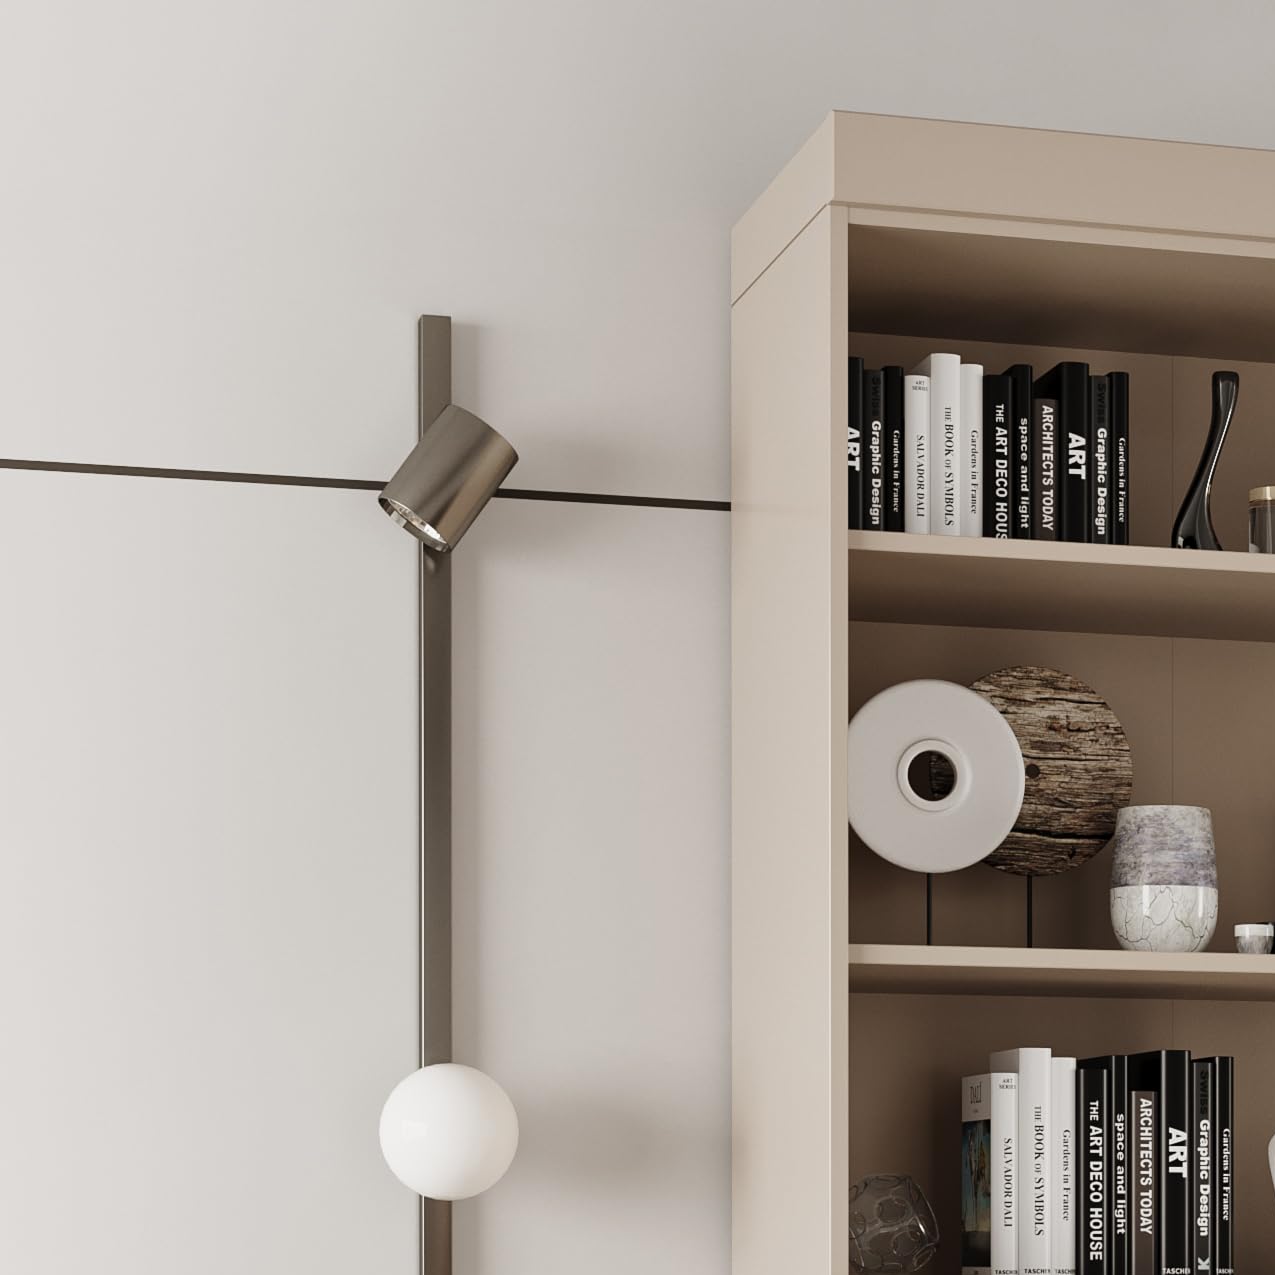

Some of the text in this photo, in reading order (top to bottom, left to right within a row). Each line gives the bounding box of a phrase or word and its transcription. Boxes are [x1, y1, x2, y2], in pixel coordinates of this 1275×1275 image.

[995, 403, 1008, 539] THE ART DECO HOUS
[1018, 417, 1030, 529] space and light
[1042, 405, 1054, 531] ARCHITECTS TODAY
[1068, 432, 1086, 480] ART
[1095, 427, 1108, 483] Graphic
[1095, 487, 1108, 535] Design
[1003, 1138, 1012, 1200] SALVADOR
[1033, 1125, 1044, 1160] BOOK
[1089, 1100, 1102, 1261] THE ART DECO HOUSE
[1115, 1113, 1126, 1235] space and light
[1139, 1098, 1152, 1235] ARCHITECTS TODAY
[1168, 1127, 1187, 1178] ART
[1196, 1119, 1210, 1236] Graphic Design
[1033, 1177, 1044, 1236] SYMBOLS
